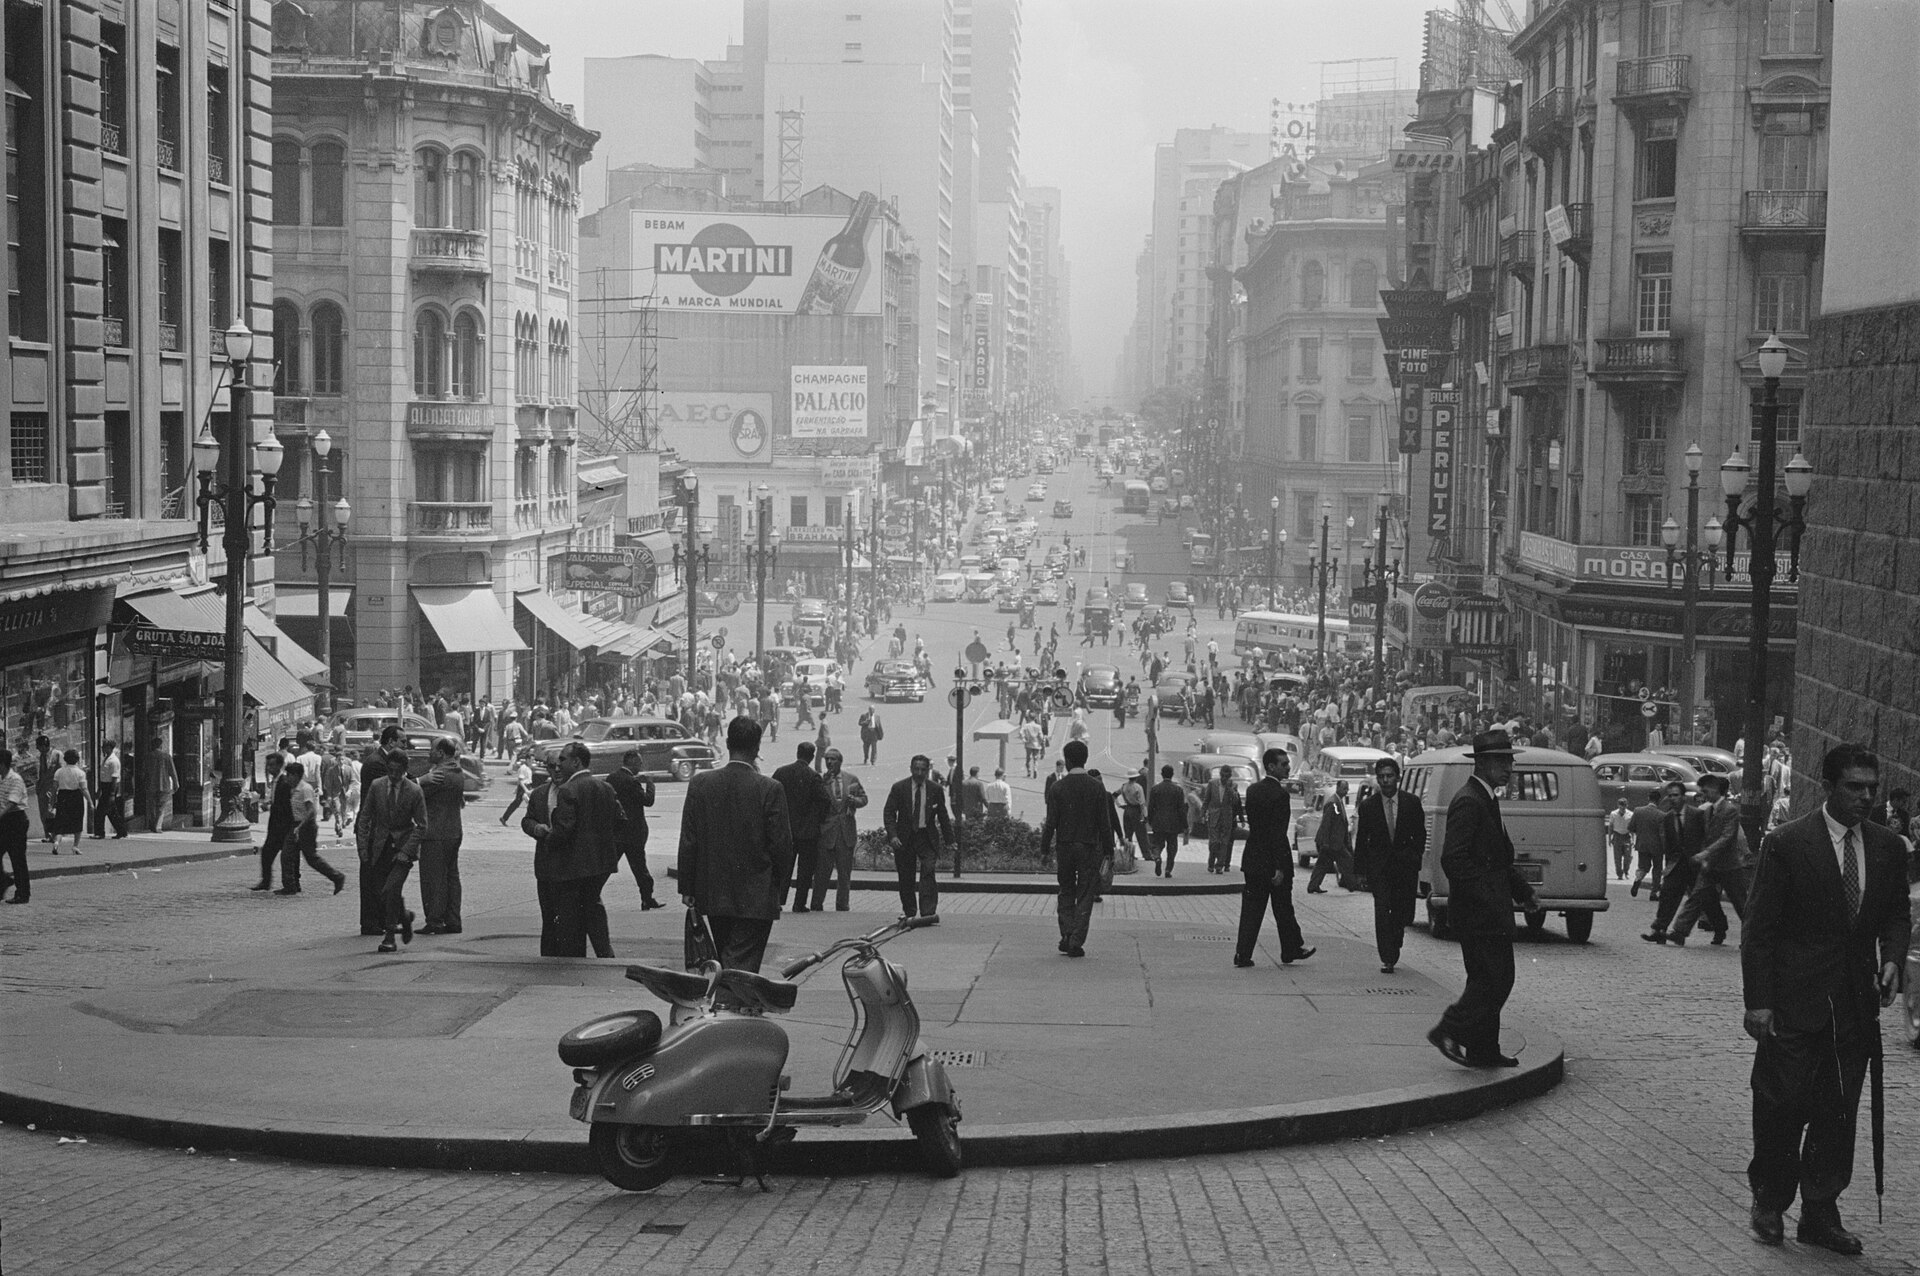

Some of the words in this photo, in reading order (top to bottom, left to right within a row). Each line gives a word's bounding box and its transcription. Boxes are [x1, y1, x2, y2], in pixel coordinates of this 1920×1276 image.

[1393, 154, 1455, 168] LOJAS
[644, 220, 685, 230] BEBAM
[660, 246, 786, 274] MARTINI
[820, 257, 857, 283] MARTINI
[662, 296, 670, 305] A
[678, 296, 721, 307] MARCA
[729, 298, 783, 309] MUNDIAL
[1401, 348, 1428, 359] CINE
[976, 337, 986, 386] GARBO
[1400, 362, 1428, 373] FOTO
[794, 374, 866, 385] CHAMPAGNE
[795, 392, 865, 412] PALACIO
[1431, 391, 1461, 403] FILMES
[658, 403, 733, 423] AEG
[1404, 383, 1420, 446] FOX
[1431, 410, 1451, 531] PERUTZ
[790, 533, 834, 541] BRAHMA
[1620, 552, 1651, 561] CASA
[565, 581, 604, 589] ESPECIAL
[1351, 603, 1377, 620] CINZ
[136, 630, 175, 644] GRUTA
[203, 634, 226, 648] JOÃ
